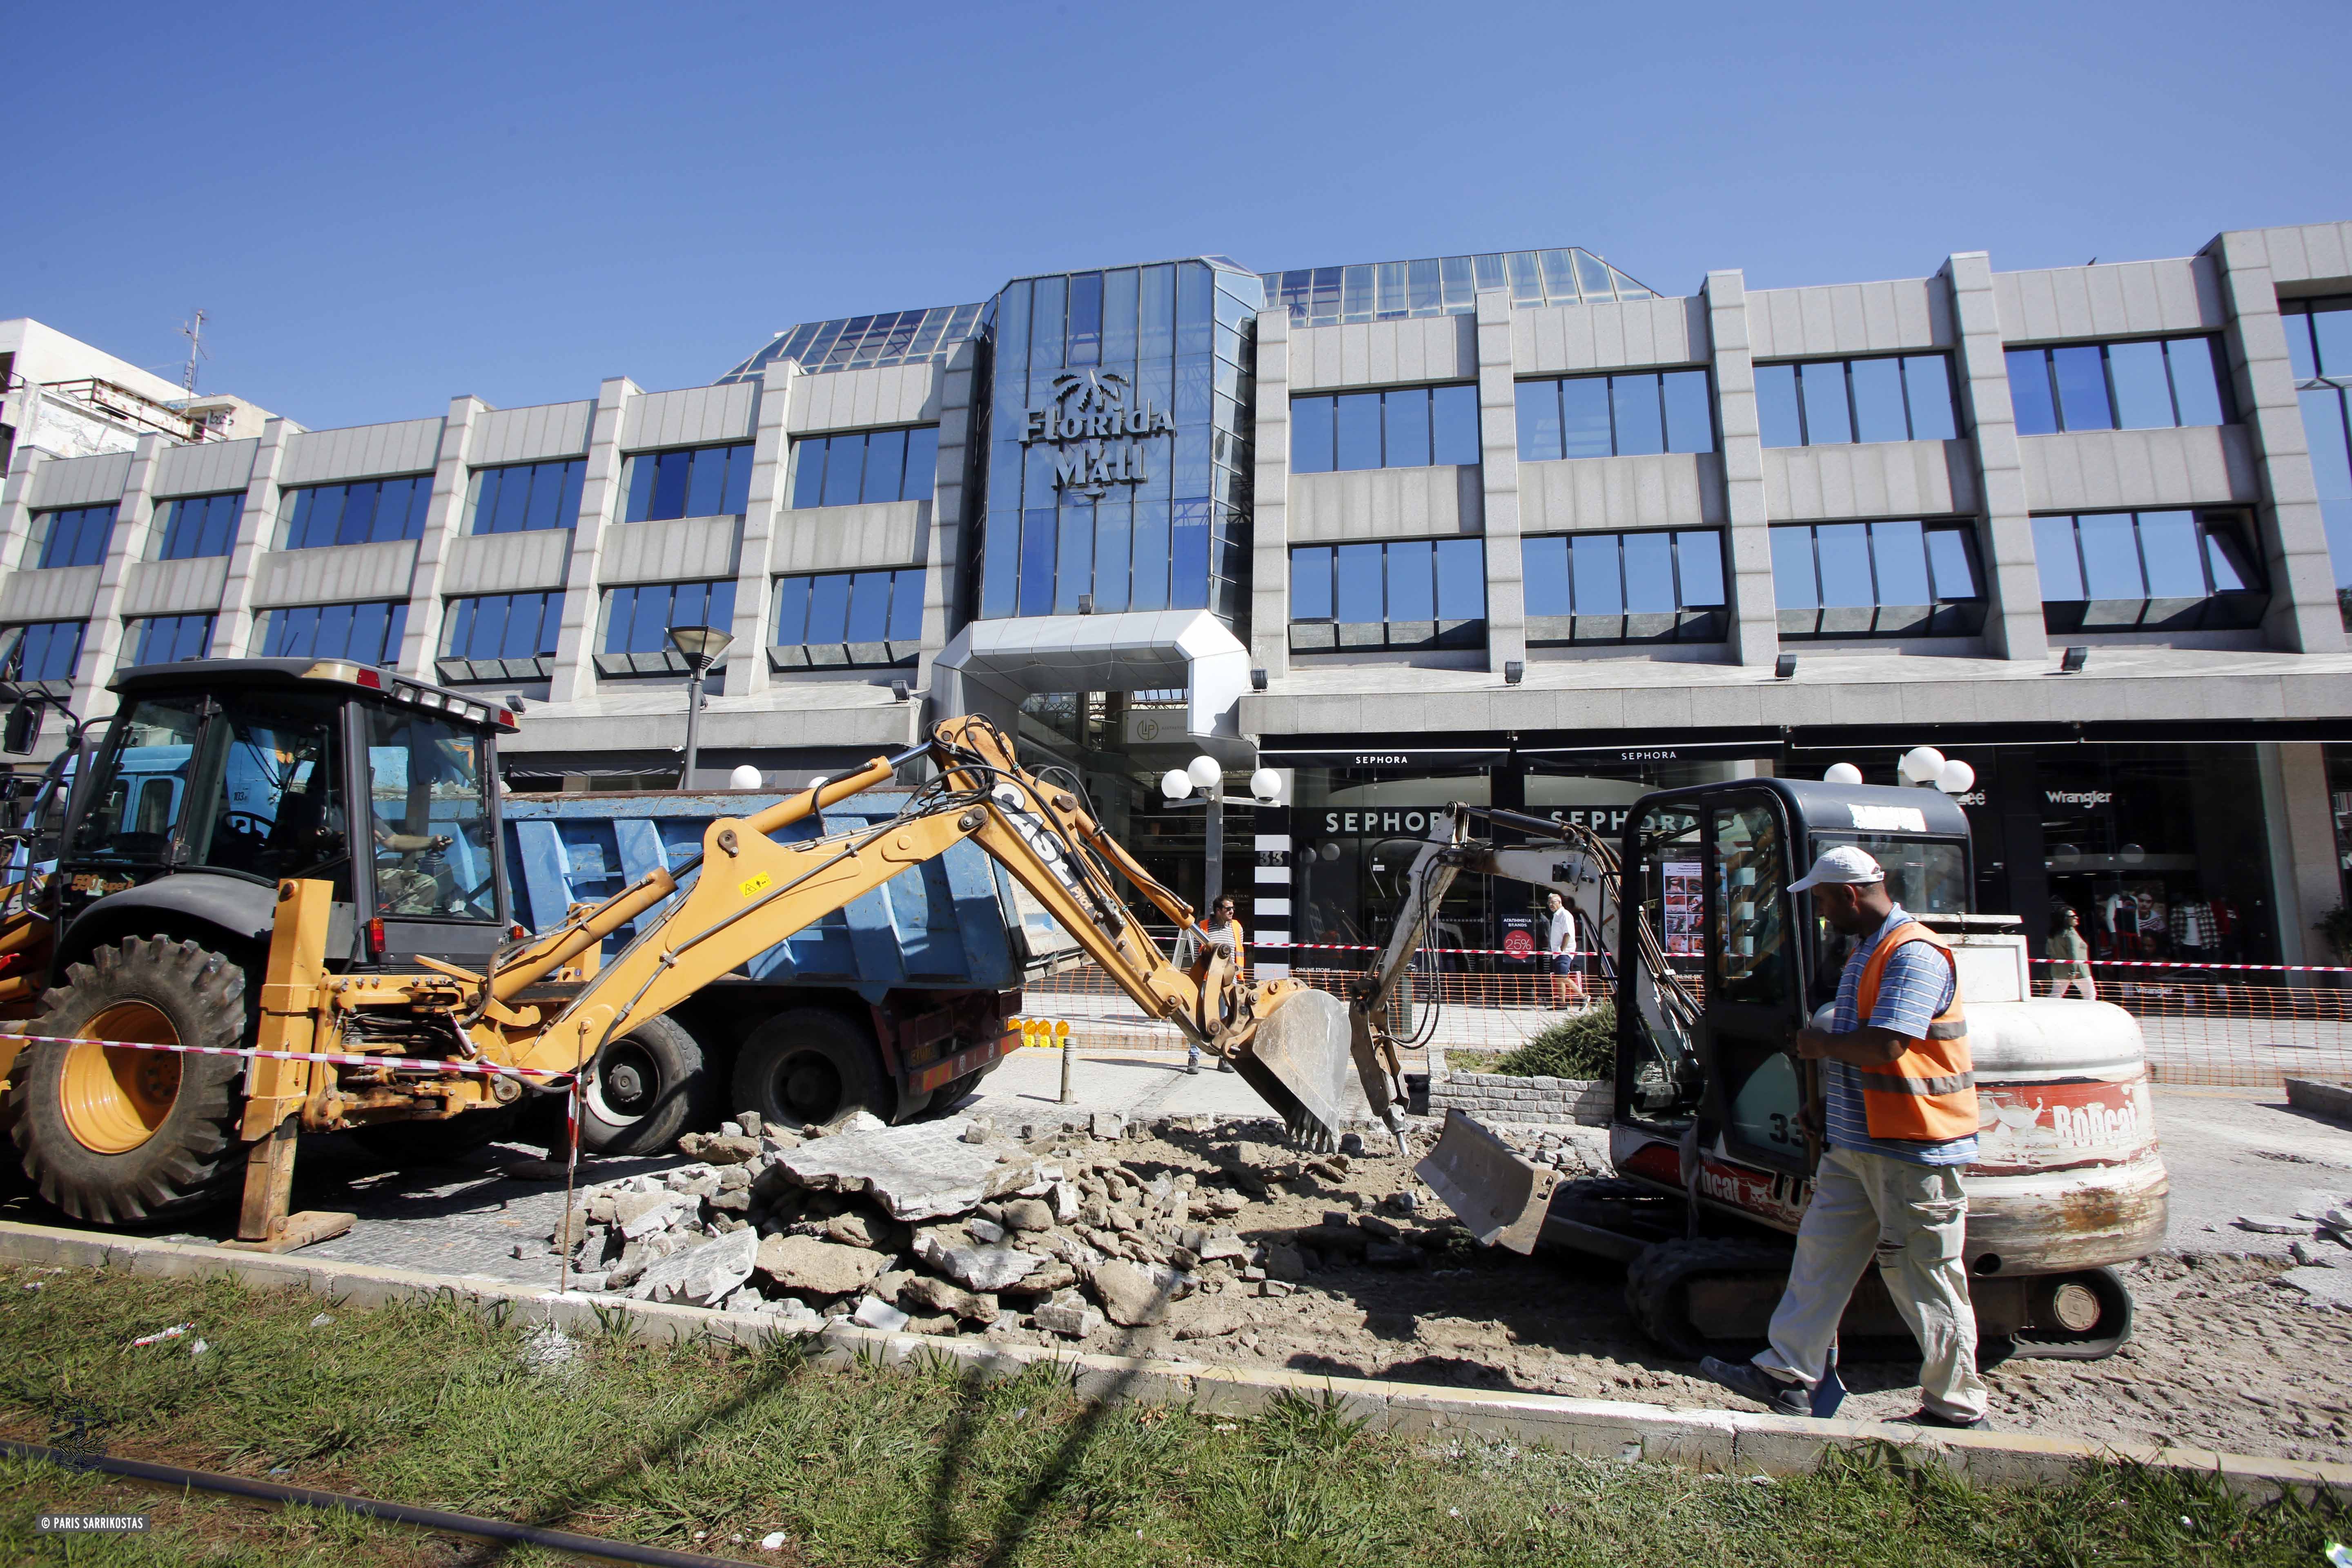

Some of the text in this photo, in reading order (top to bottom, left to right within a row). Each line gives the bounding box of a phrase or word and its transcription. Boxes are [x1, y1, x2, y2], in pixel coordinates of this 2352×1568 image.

[1621, 751, 1676, 760] SEPHORA
[1958, 792, 1986, 805] ee
[2045, 791, 2112, 808] Wrangler
[1326, 812, 1442, 832] SEPHO
[1260, 851, 1283, 866] 33
[71, 874, 100, 891] 590
[1506, 939, 1531, 950] 25%
[2052, 1100, 2137, 1149] Bobcat
[1680, 1160, 1743, 1205] bcat
